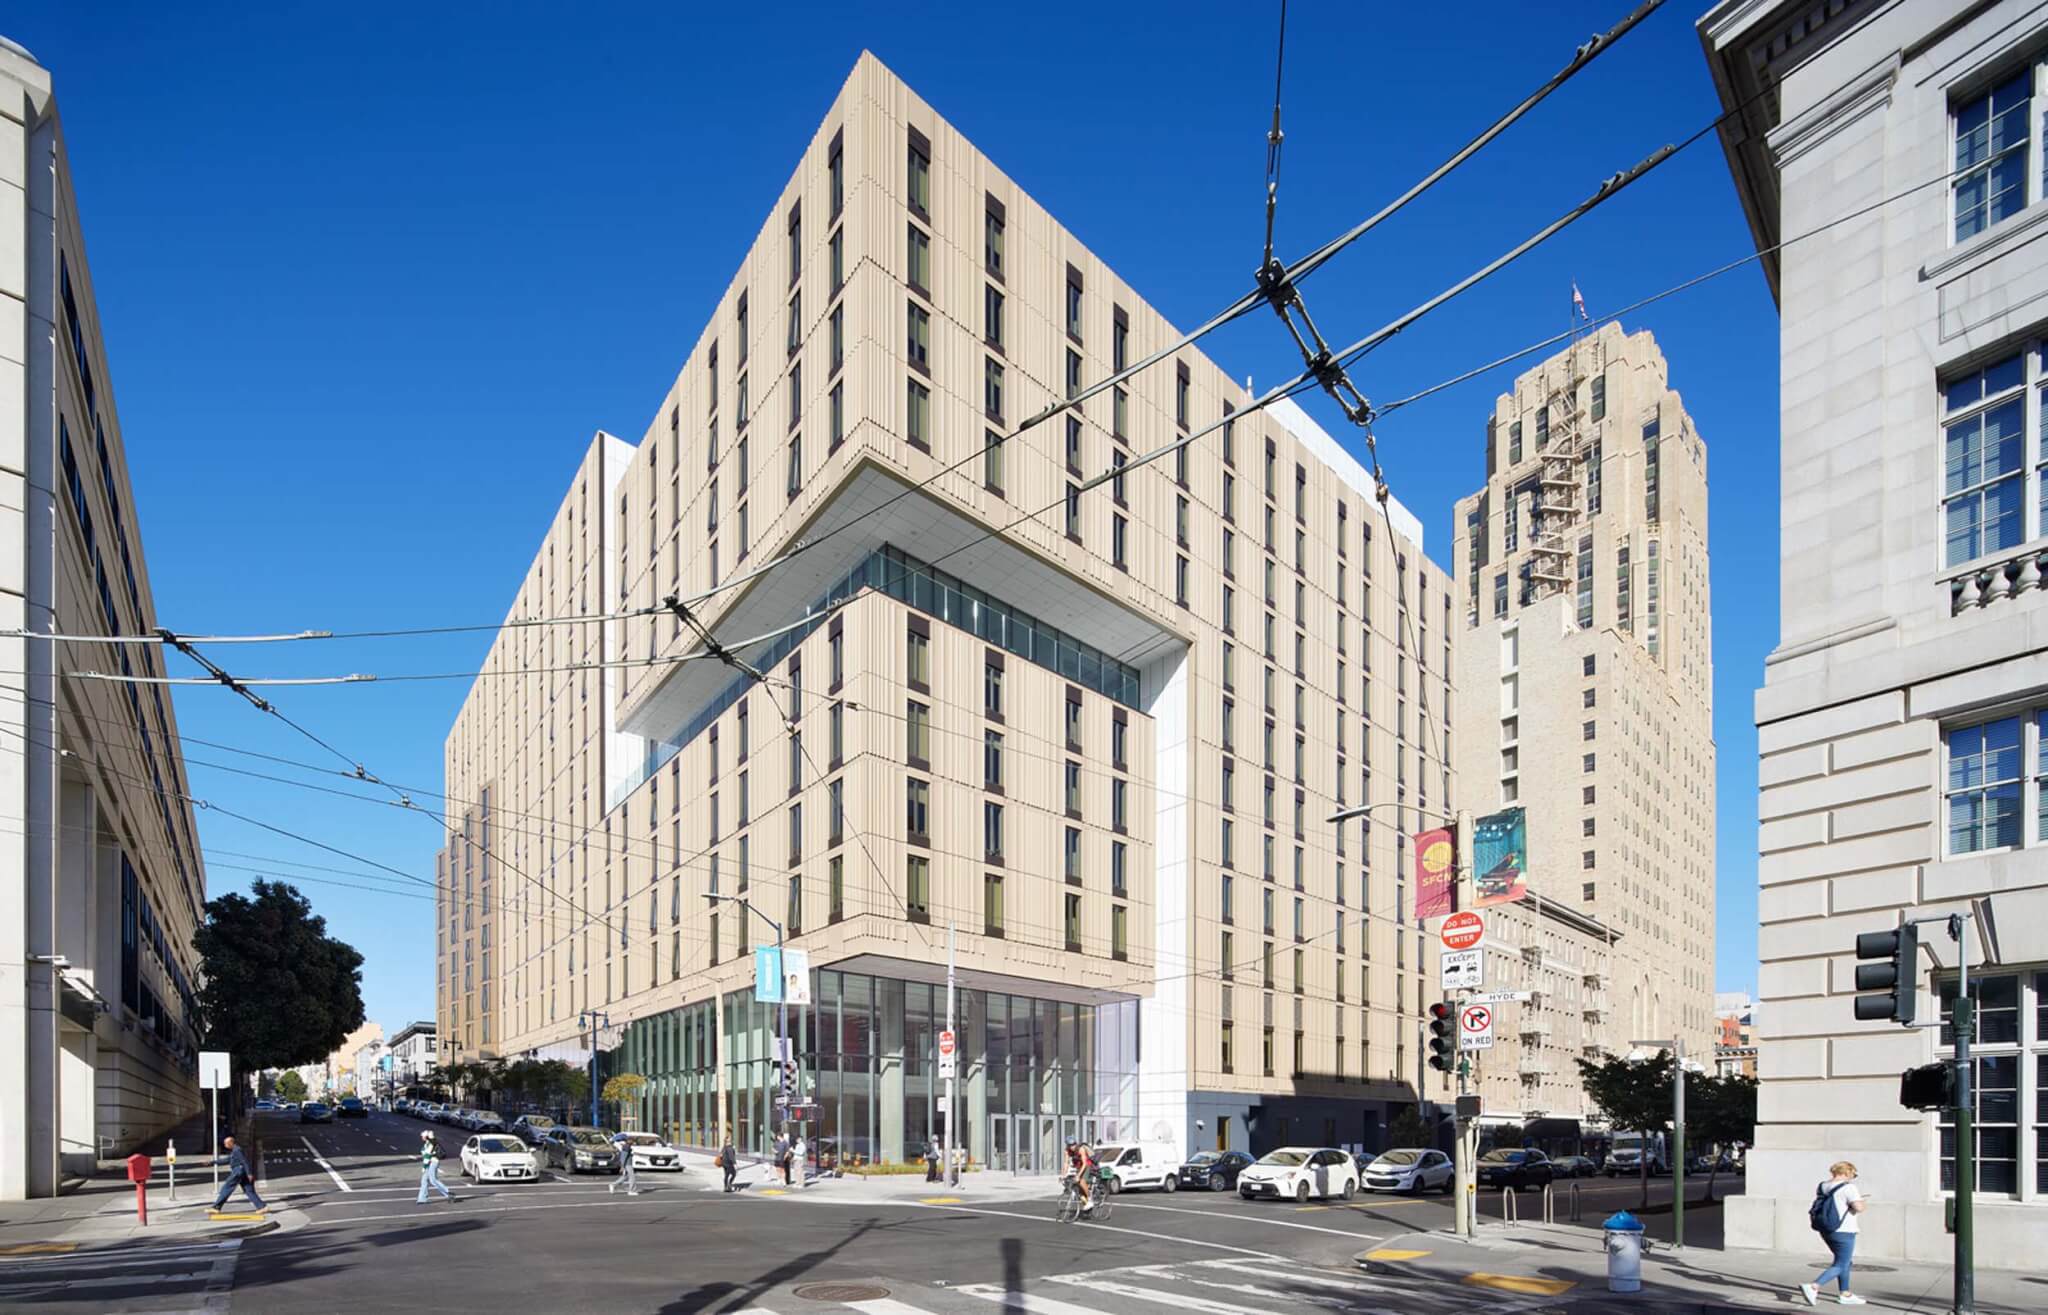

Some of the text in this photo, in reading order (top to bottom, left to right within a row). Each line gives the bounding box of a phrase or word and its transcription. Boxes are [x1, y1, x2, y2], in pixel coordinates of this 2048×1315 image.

[1446, 916, 1477, 929] DO NOT
[1449, 934, 1475, 945] ENTER
[1448, 953, 1476, 963] EXCEPT
[1489, 993, 1516, 1001] HYDE
[1461, 1036, 1492, 1046] ON RED
